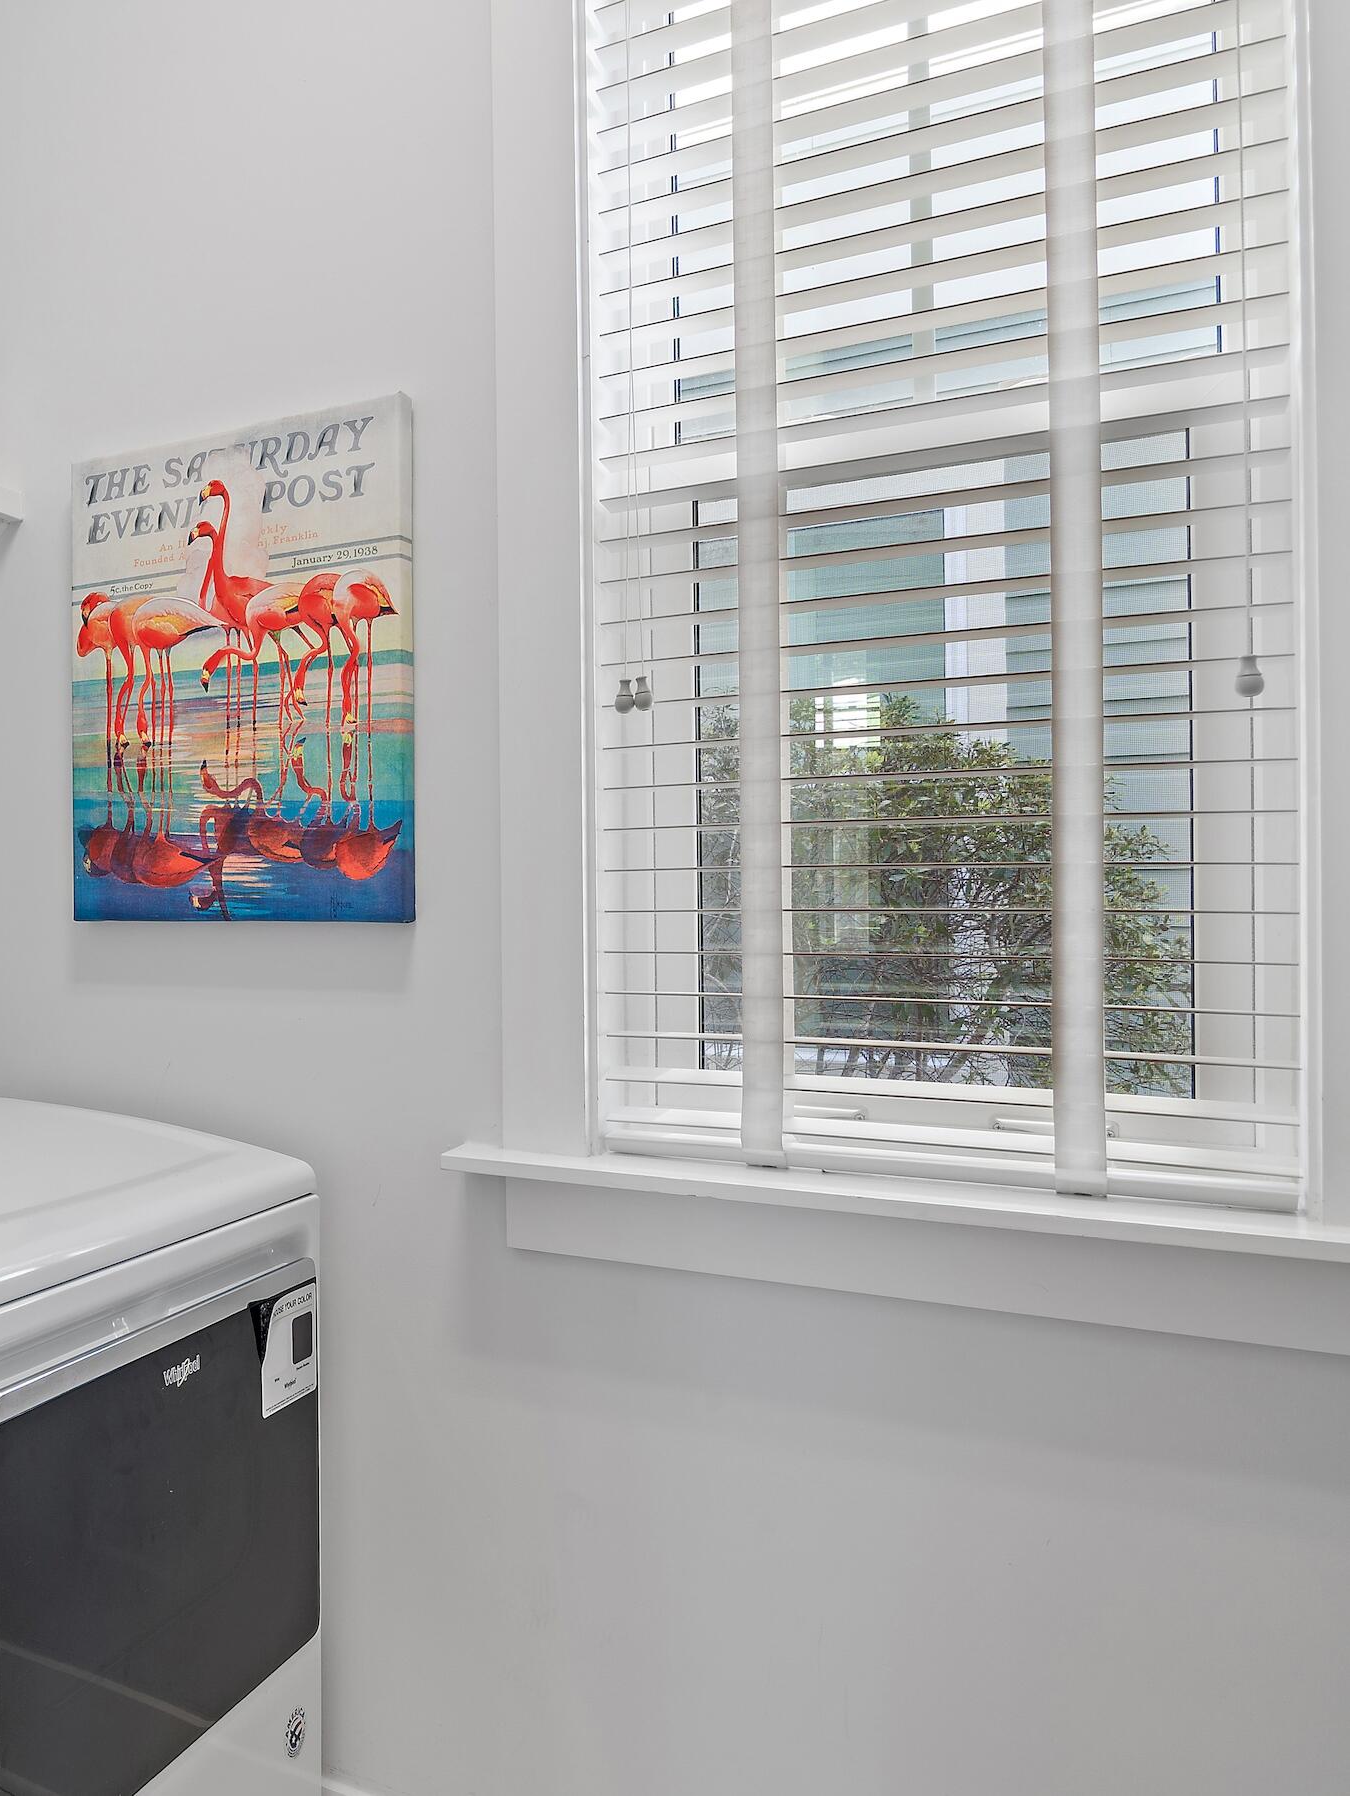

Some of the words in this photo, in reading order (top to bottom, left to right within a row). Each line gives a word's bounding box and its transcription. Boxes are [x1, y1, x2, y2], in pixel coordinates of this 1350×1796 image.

[85, 464, 152, 507] THE
[162, 416, 374, 488] SARDAY
[86, 496, 208, 545] EVENI
[261, 462, 375, 514] POST
[133, 554, 175, 567] Founded
[273, 530, 319, 545] Franklin
[291, 553, 334, 568] January
[353, 546, 379, 558] 1938
[134, 582, 154, 593] Copy
[163, 1354, 201, 1387] Whirlpool
